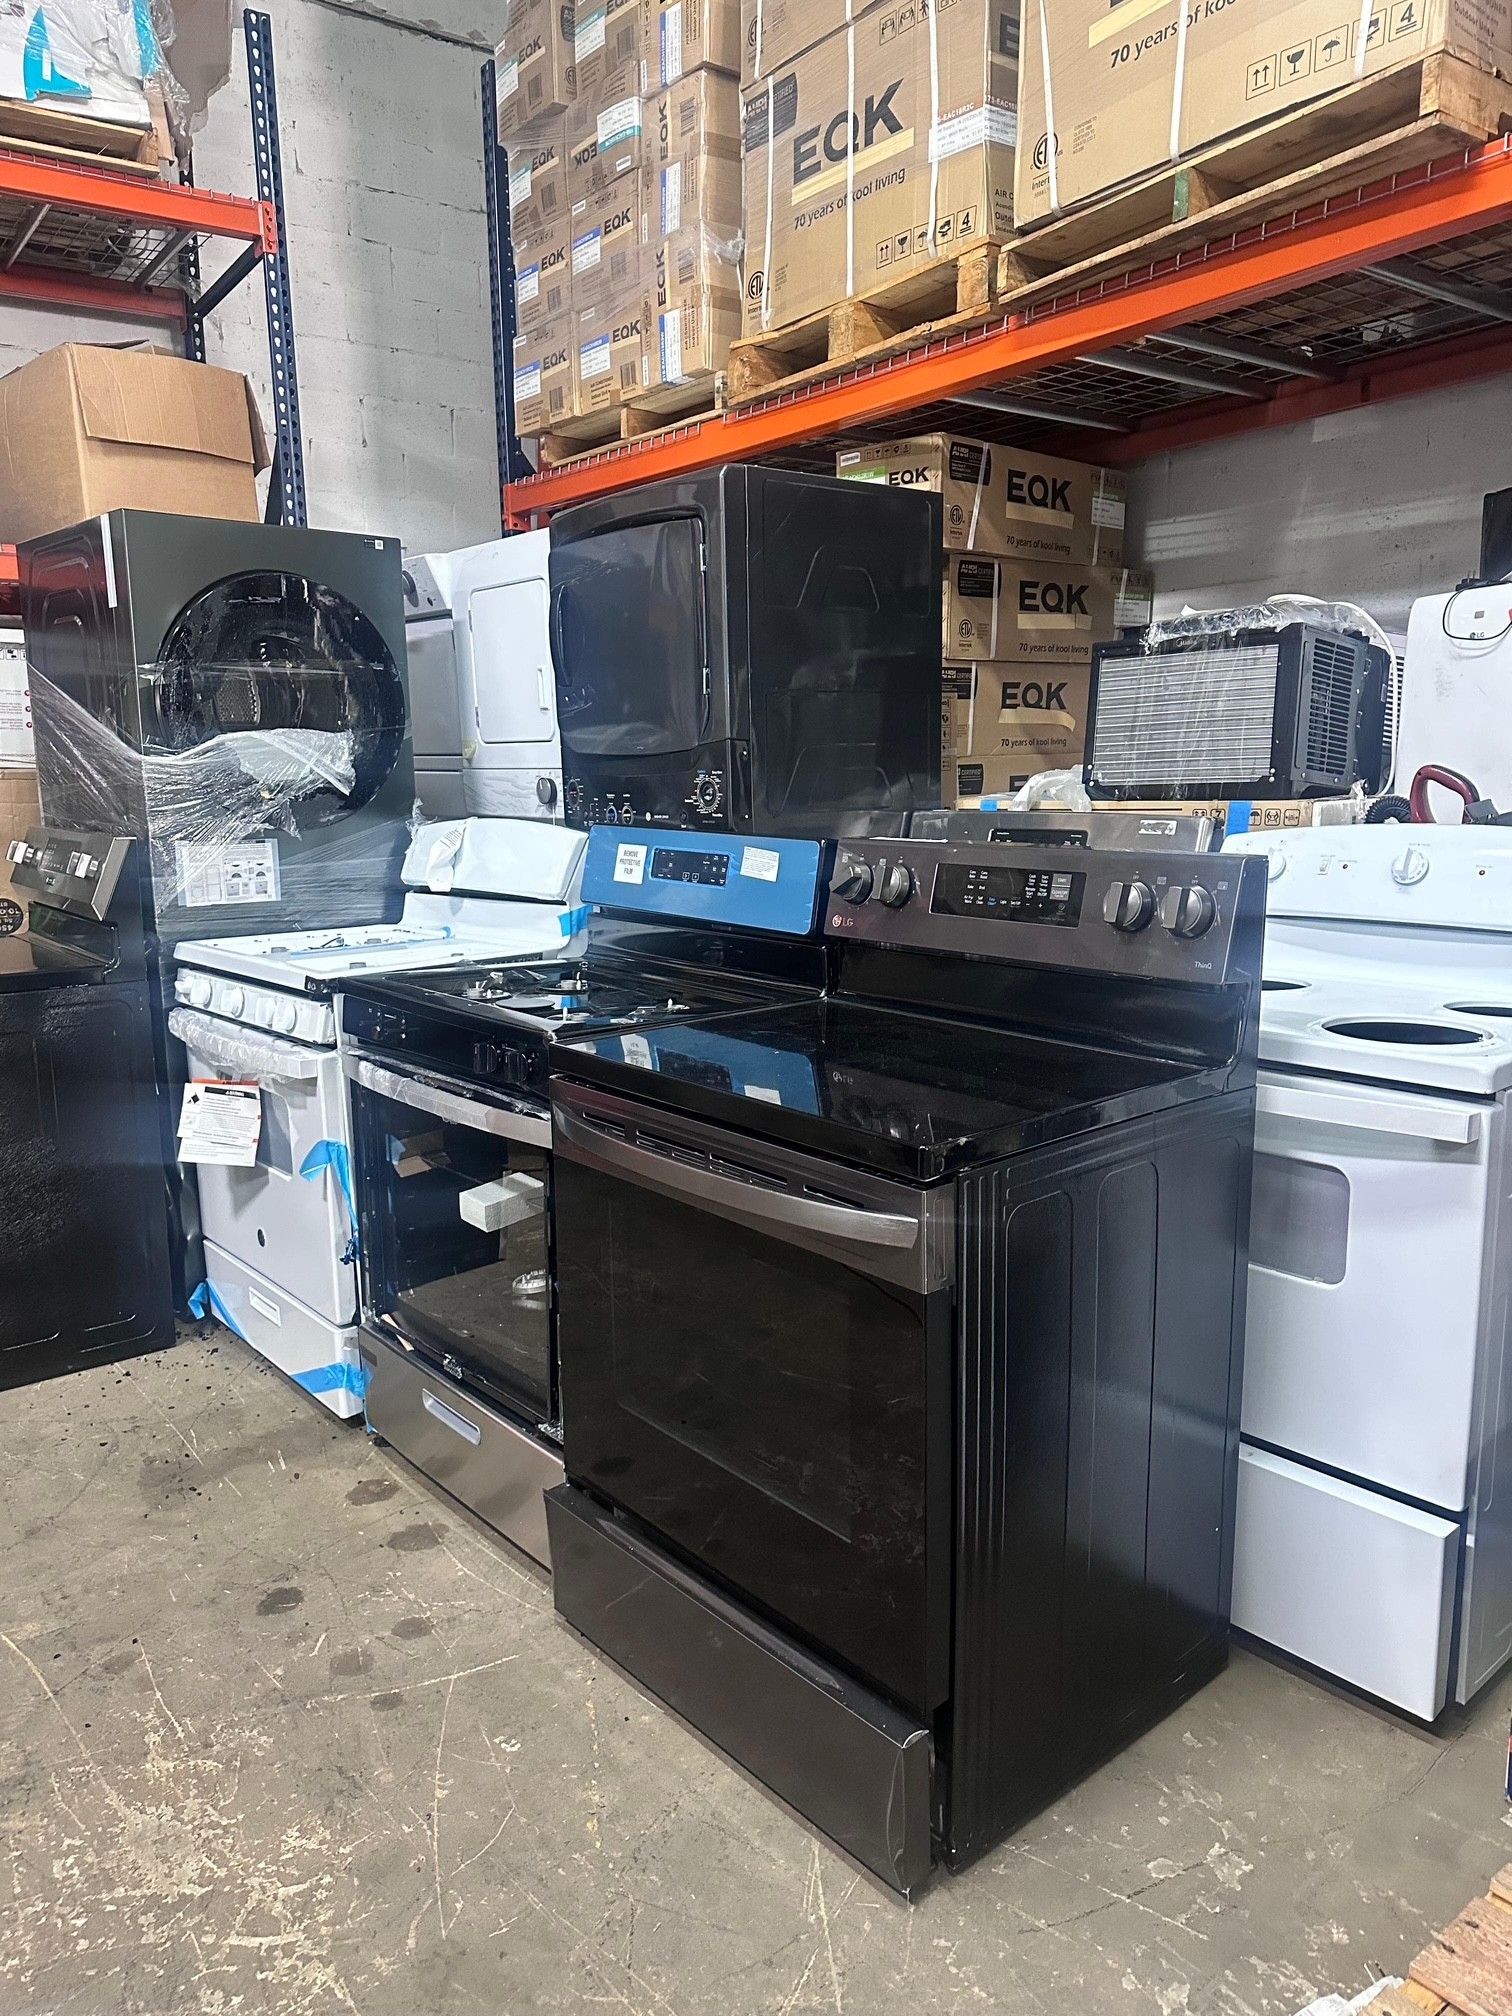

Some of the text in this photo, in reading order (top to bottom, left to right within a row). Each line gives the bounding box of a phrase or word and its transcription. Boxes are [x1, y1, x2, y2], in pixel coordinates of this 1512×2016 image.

[1400, 2, 1414, 23] 4
[518, 34, 542, 67] EQK
[1111, 43, 1131, 69] 70
[1134, 21, 1178, 61] years
[659, 99, 669, 161] EQK
[793, 78, 905, 185] EQK
[531, 145, 556, 173] EQK
[573, 143, 599, 170] EQK
[794, 214, 806, 231] 70
[808, 201, 834, 227] years
[836, 193, 848, 209] of
[874, 167, 906, 191] living
[994, 188, 1008, 199] AIR
[603, 206, 632, 237] EQK
[961, 211, 971, 228] 4
[541, 245, 566, 272] EQK
[656, 248, 667, 308] EQK
[612, 319, 641, 343] EQK
[543, 348, 567, 372] EQK
[888, 466, 930, 487] EQK
[1007, 468, 1073, 513] EQK
[1006, 535, 1015, 545] 70
[1015, 538, 1032, 549] years
[1018, 579, 1092, 616] EQK
[1019, 642, 1089, 656] 70 years of kool living
[1001, 681, 1068, 710] EQK
[1001, 737, 1067, 749] 70 years of kool living
[619, 858, 641, 867] PROTECTIVE
[623, 849, 639, 858] REMOVE
[624, 867, 634, 876] FILM
[842, 917, 854, 926] LG
[1194, 960, 1213, 970] ThinQ
